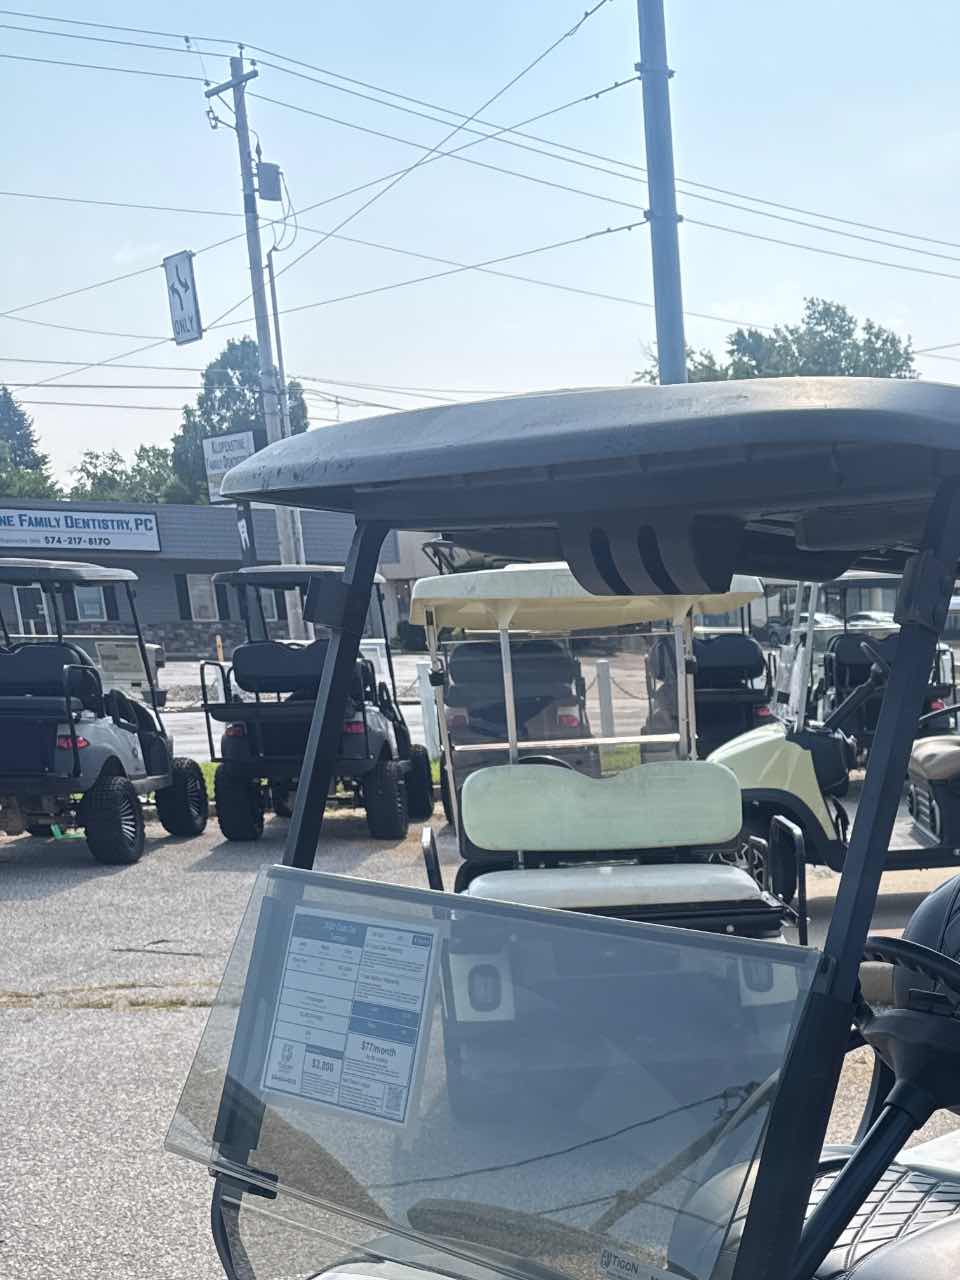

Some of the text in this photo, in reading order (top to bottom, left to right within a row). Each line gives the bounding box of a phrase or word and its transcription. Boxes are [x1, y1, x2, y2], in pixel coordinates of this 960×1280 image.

[175, 312, 194, 336] ONLY
[18, 514, 61, 529] FAMILY
[64, 515, 133, 532] DENTISTRY,
[135, 518, 154, 531] PC
[44, 536, 111, 546] 574-217-8170
[613, 1255, 639, 1275] TIGON
